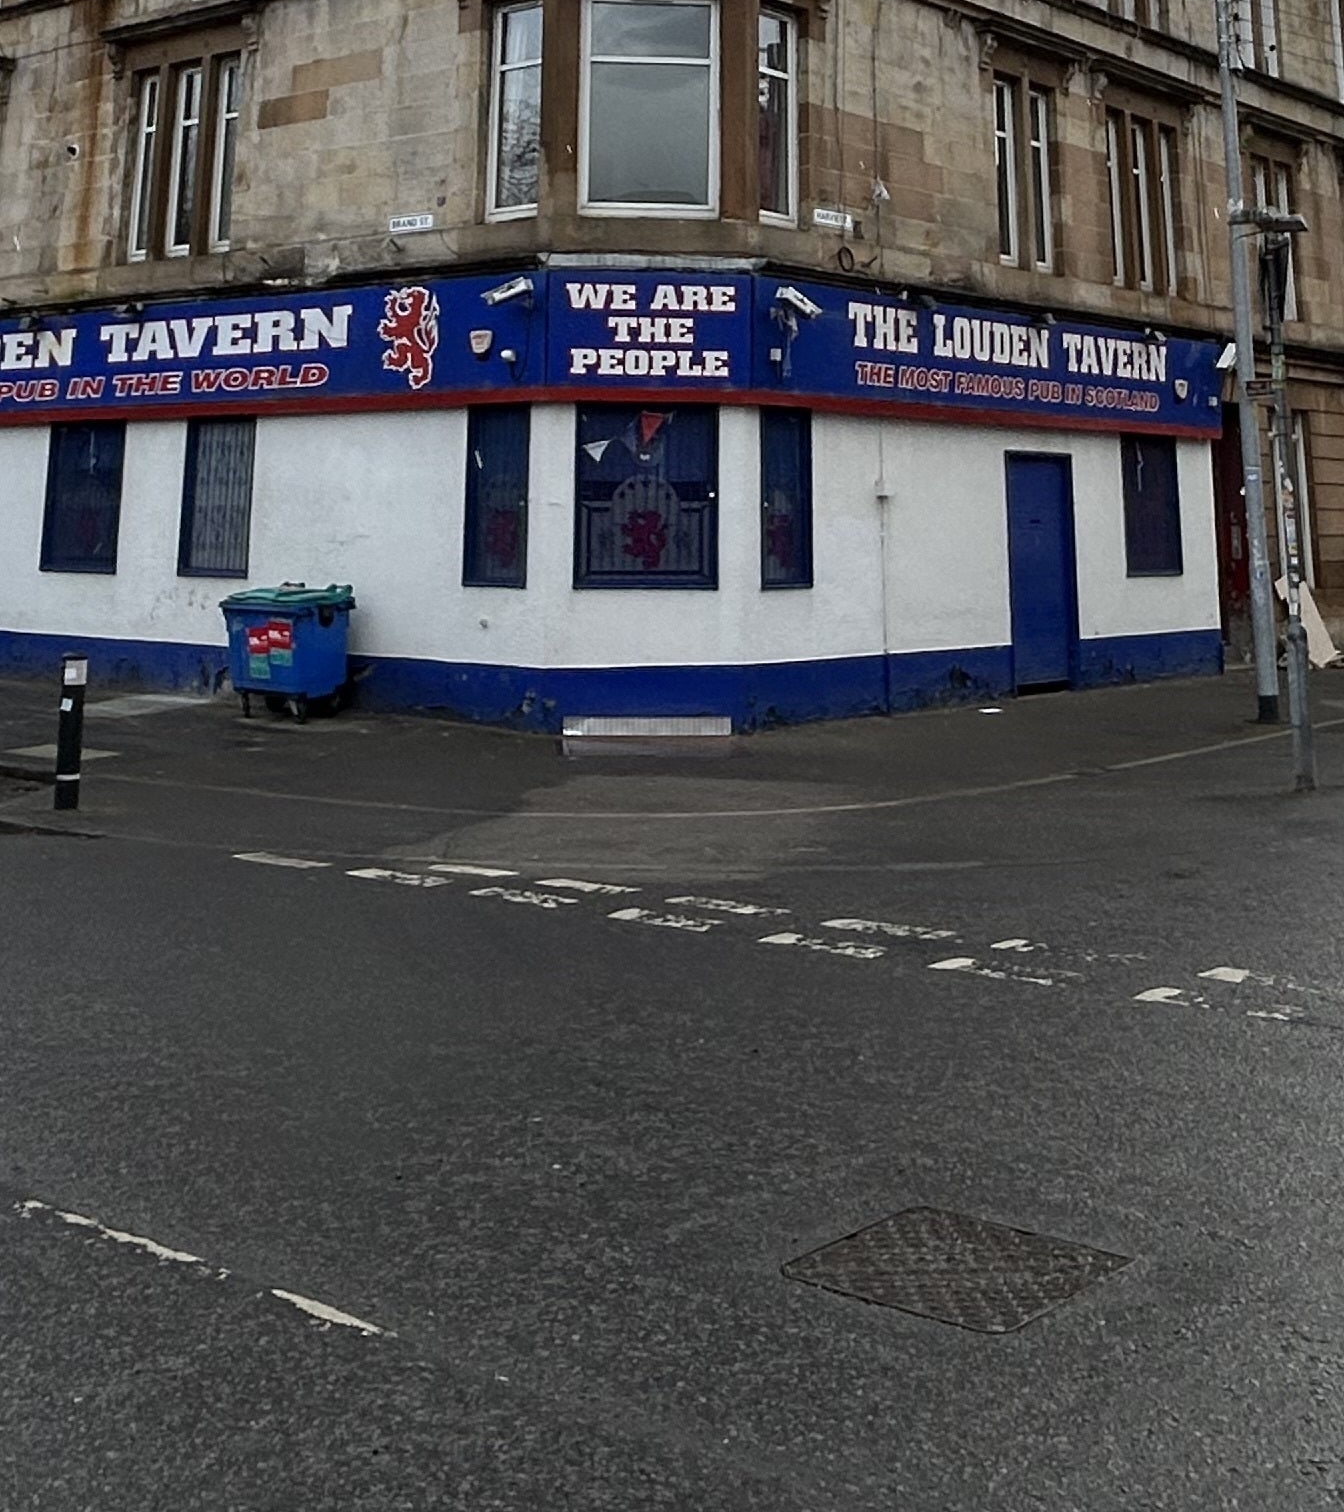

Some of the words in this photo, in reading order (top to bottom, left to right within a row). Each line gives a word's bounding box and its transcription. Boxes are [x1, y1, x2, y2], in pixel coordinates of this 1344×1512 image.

[392, 218, 417, 229] BRAND
[566, 283, 636, 310] WE
[650, 285, 736, 311] ARE
[100, 304, 353, 363] TAVERN
[608, 316, 694, 343] THE
[848, 301, 918, 354] THE
[933, 313, 1049, 369] LOUDEN
[1062, 332, 1167, 382] TAVERN
[570, 348, 729, 377] PEOPLE
[66, 376, 106, 399] IN
[112, 371, 183, 397] THE
[190, 363, 329, 392] WORLD
[855, 361, 896, 387] THE
[898, 366, 953, 392] MOST
[954, 372, 1025, 399] FAMOUS
[1028, 379, 1062, 403] PUB
[1064, 384, 1083, 404] IN
[1084, 386, 1160, 412] SCOTLAND
